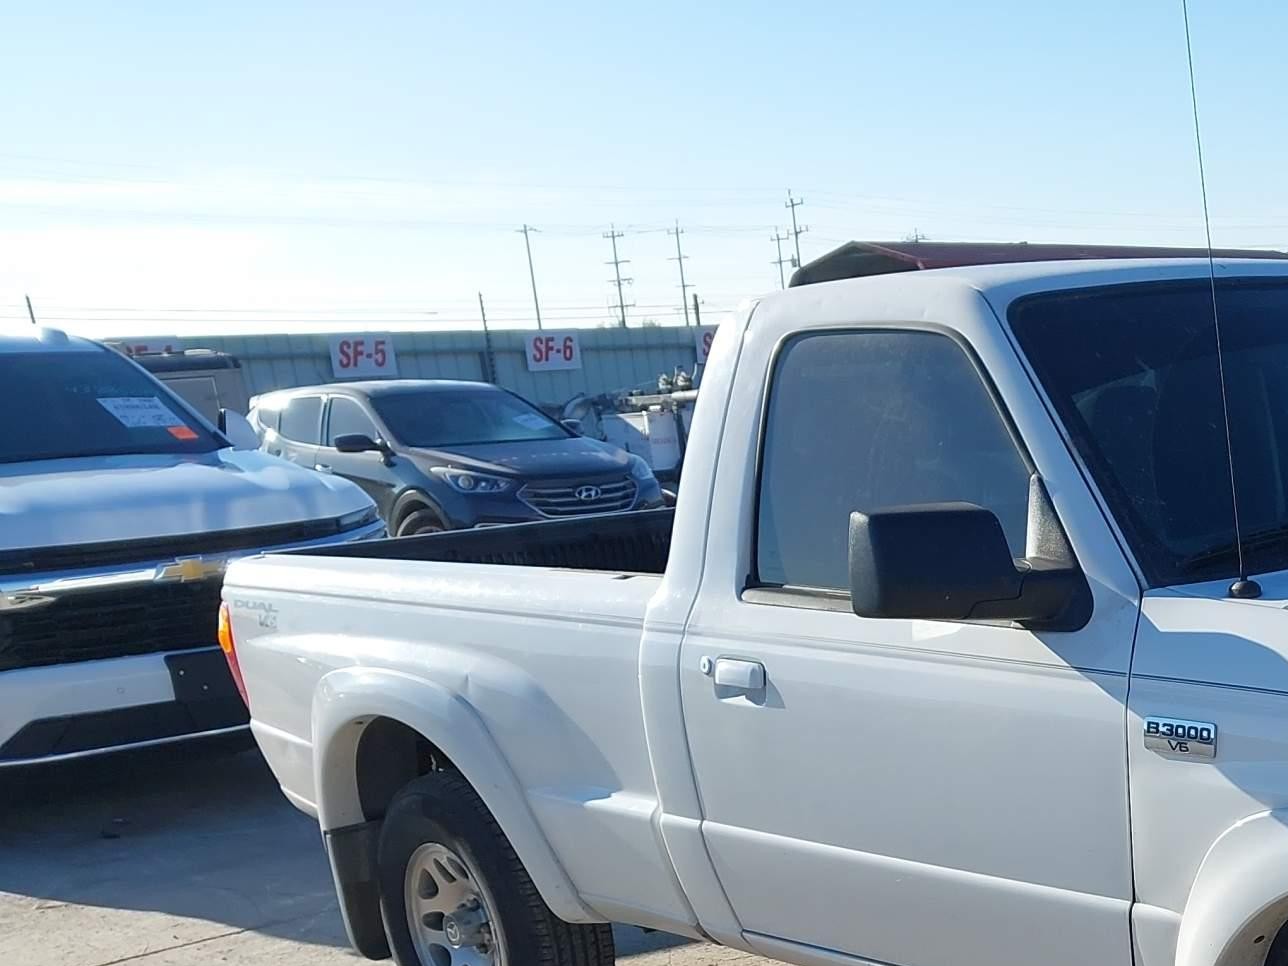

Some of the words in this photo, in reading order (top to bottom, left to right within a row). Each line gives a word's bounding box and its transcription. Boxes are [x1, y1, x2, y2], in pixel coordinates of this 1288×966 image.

[338, 339, 387, 369] SF-5
[532, 336, 574, 363] SF-6
[233, 599, 279, 613] DUAL
[1146, 721, 1211, 741] B3000
[1168, 740, 1190, 752] V6
